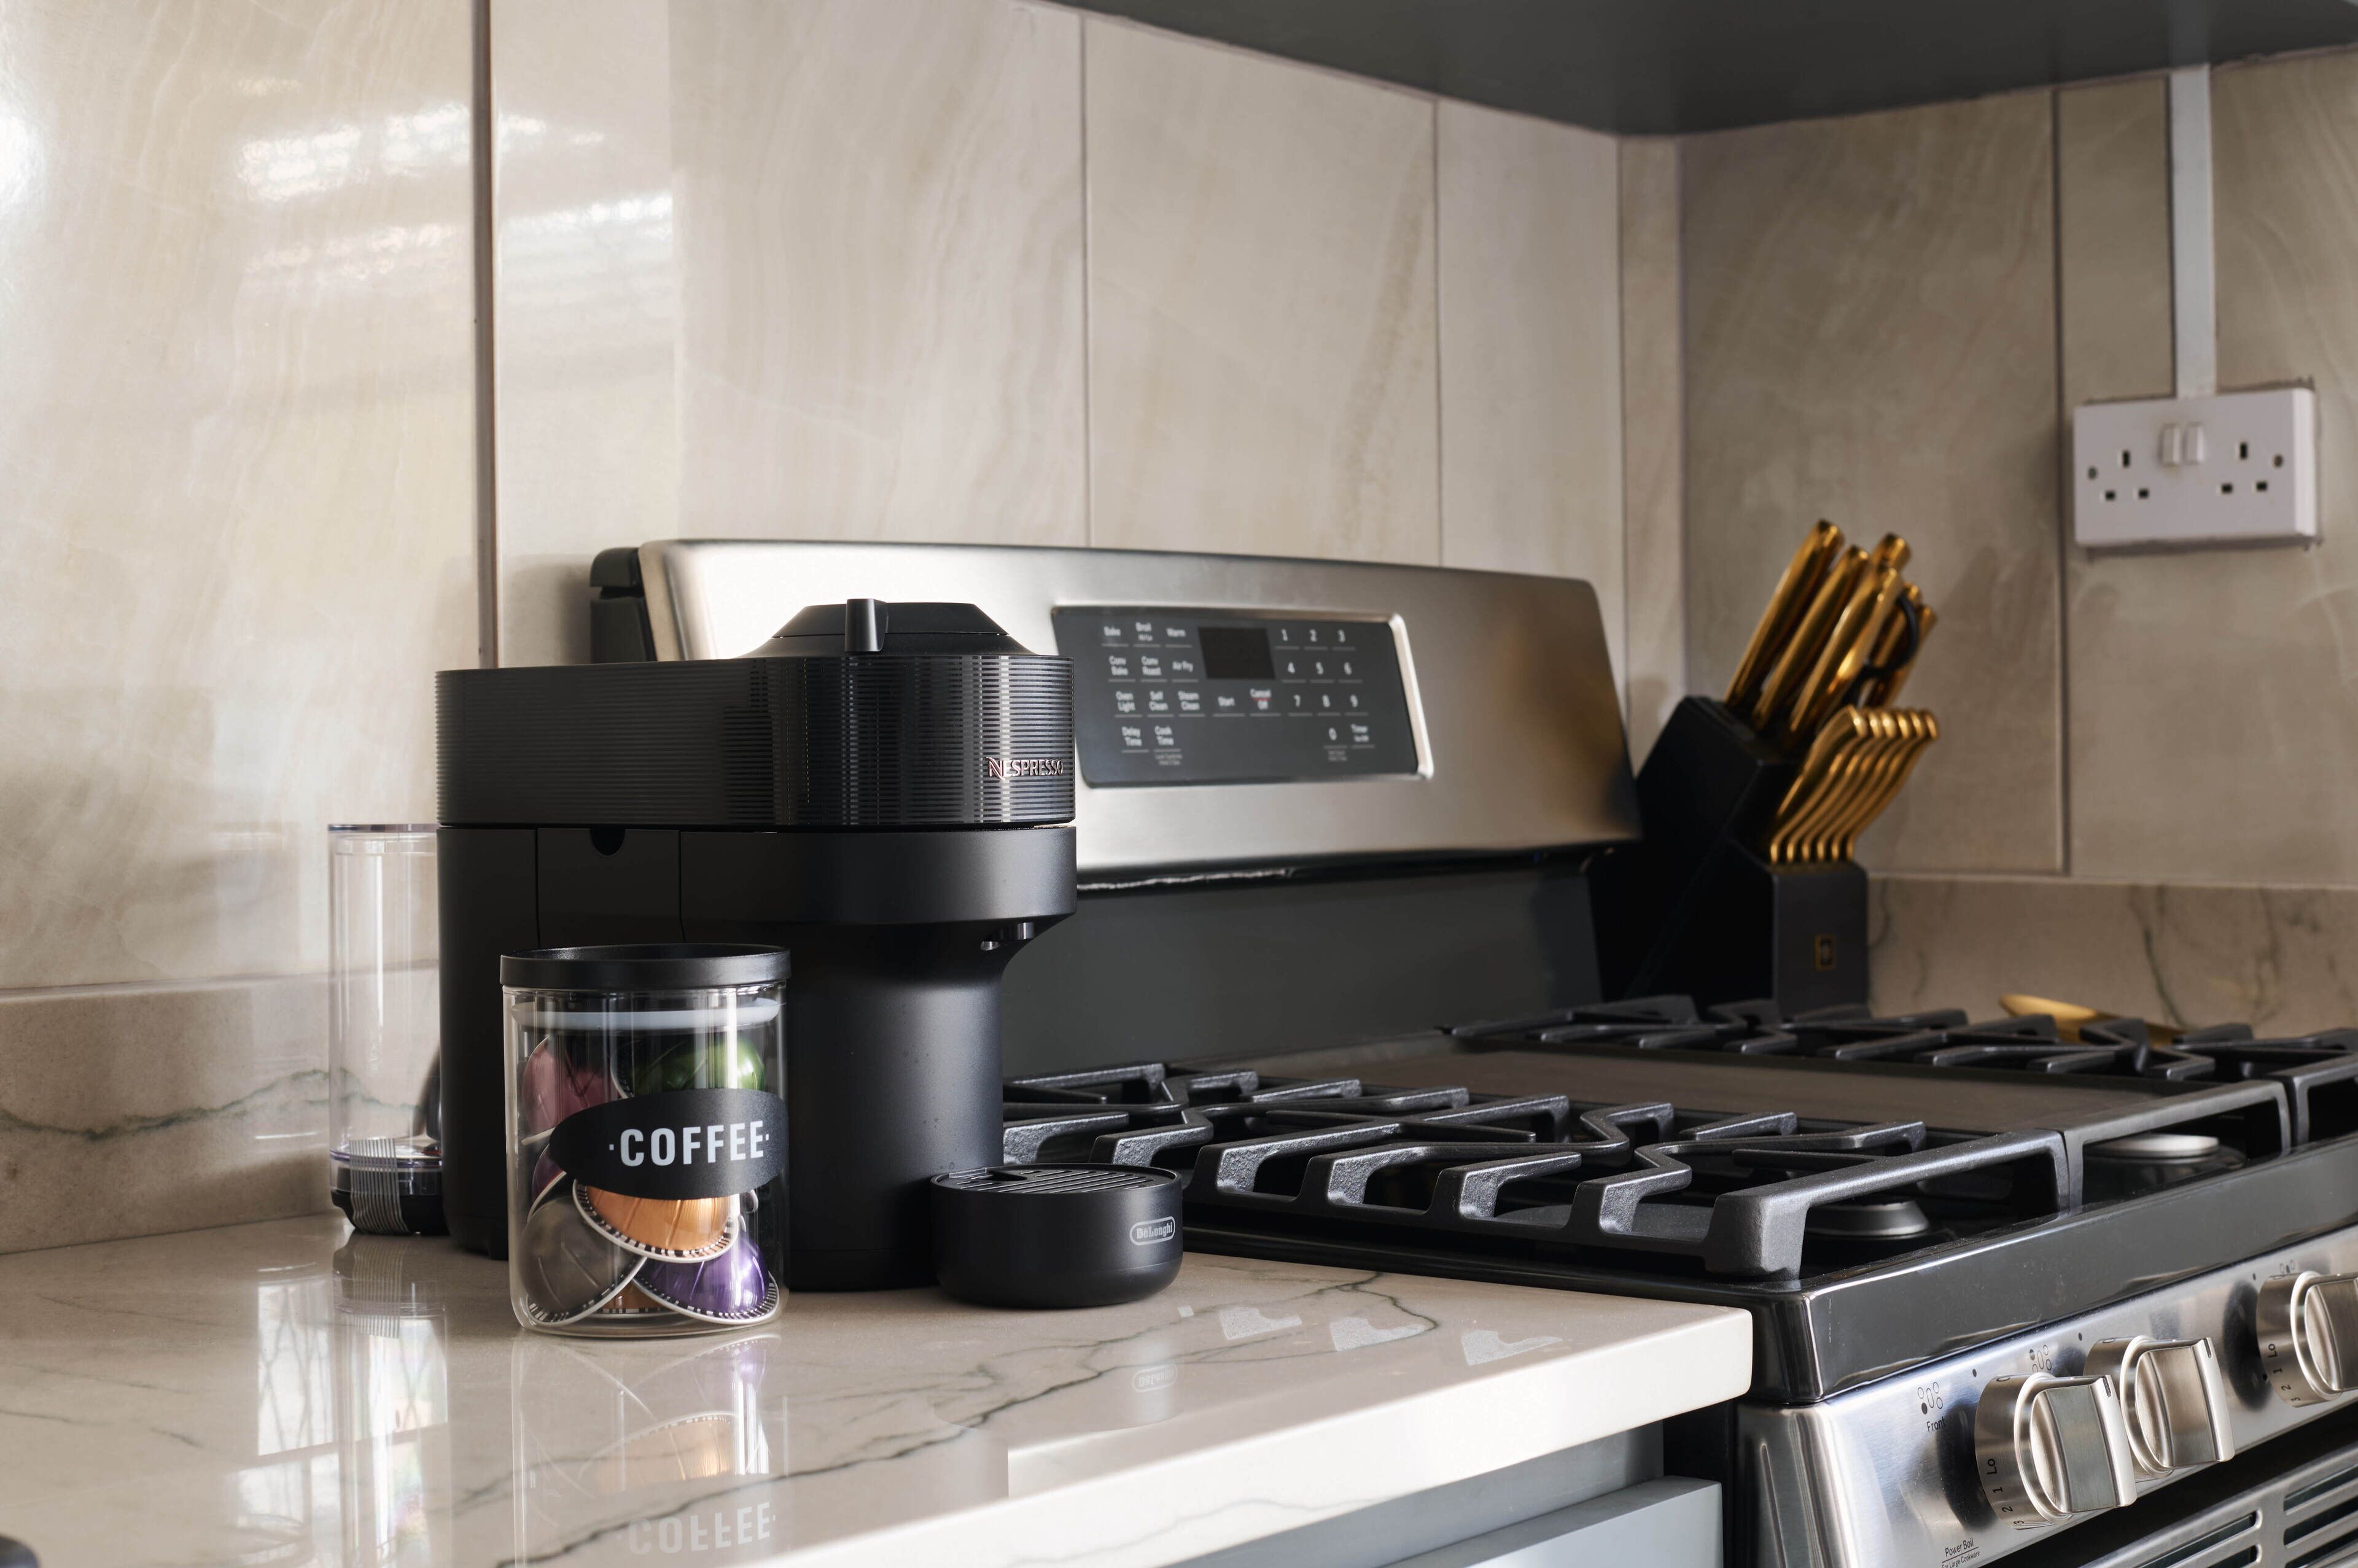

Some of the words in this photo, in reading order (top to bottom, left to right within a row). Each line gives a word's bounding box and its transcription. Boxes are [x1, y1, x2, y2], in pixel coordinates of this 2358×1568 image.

[1282, 629, 1288, 641] 1
[1310, 629, 1317, 642] 2
[1338, 629, 1345, 642] 3
[1288, 662, 1295, 673] 4
[1316, 662, 1323, 675] 5
[1344, 662, 1352, 675] 6
[1294, 694, 1301, 707] 7
[1322, 694, 1330, 707] 8
[1350, 694, 1358, 707] 9
[985, 757, 1063, 780] NESPRESSO
[620, 1120, 764, 1166] COFFEE
[1926, 1416, 1945, 1433] Front
[1945, 1543, 1963, 1558] Power
[1963, 1537, 1974, 1550] Boil
[1949, 1559, 1960, 1568] Large
[1961, 1551, 1980, 1563] Cookware
